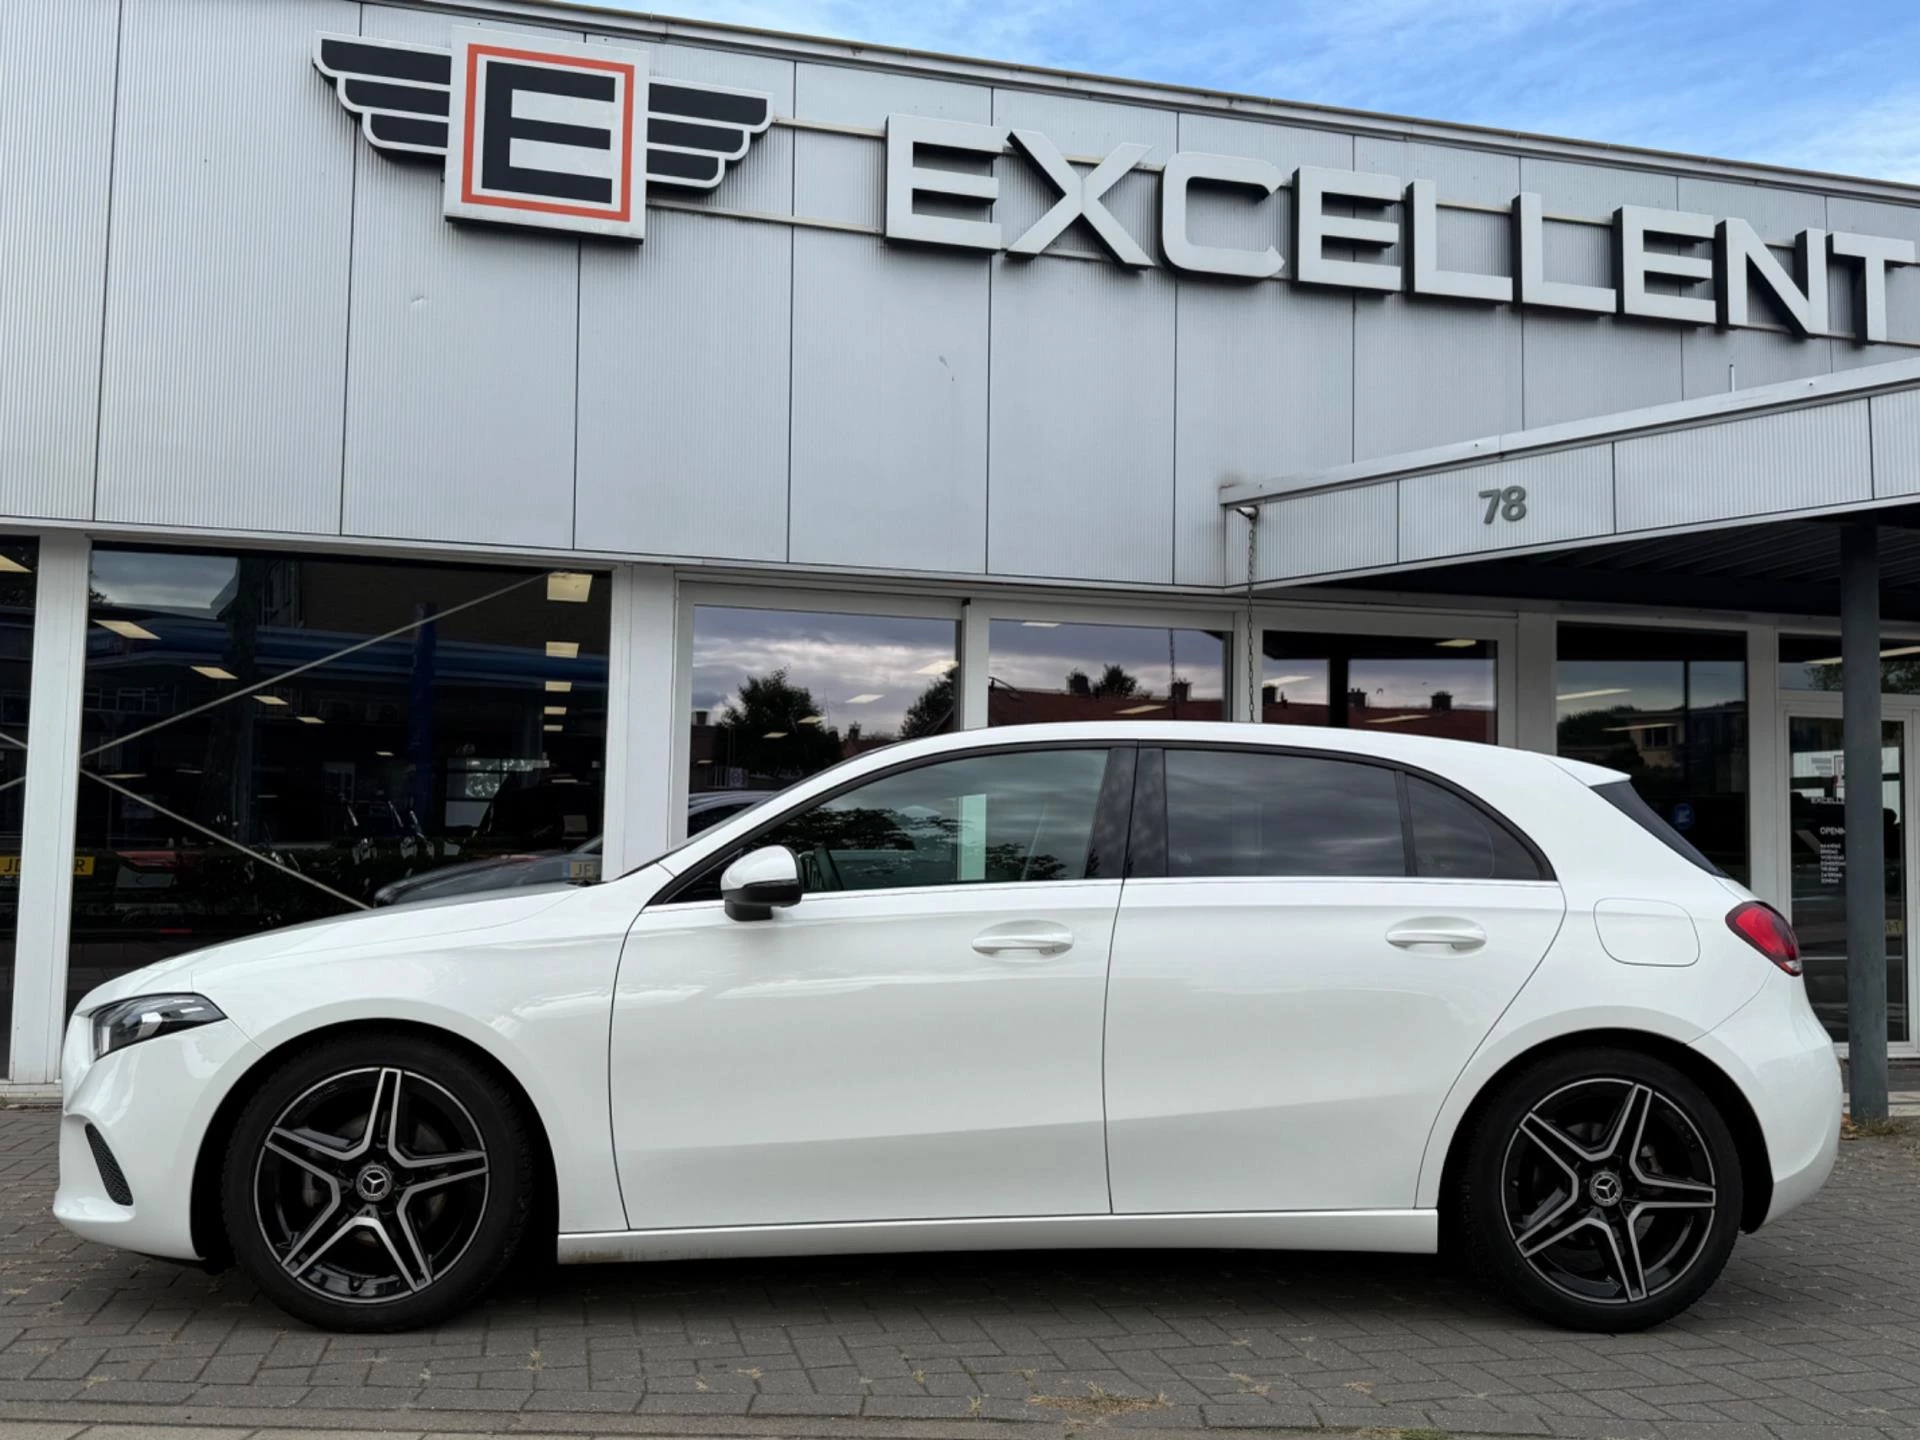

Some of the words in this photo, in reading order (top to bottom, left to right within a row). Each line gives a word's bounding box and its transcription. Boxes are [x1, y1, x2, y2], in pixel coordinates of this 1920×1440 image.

[481, 61, 616, 204] E
[885, 114, 1916, 342] EXCELLENT
[1479, 486, 1526, 524] 78
